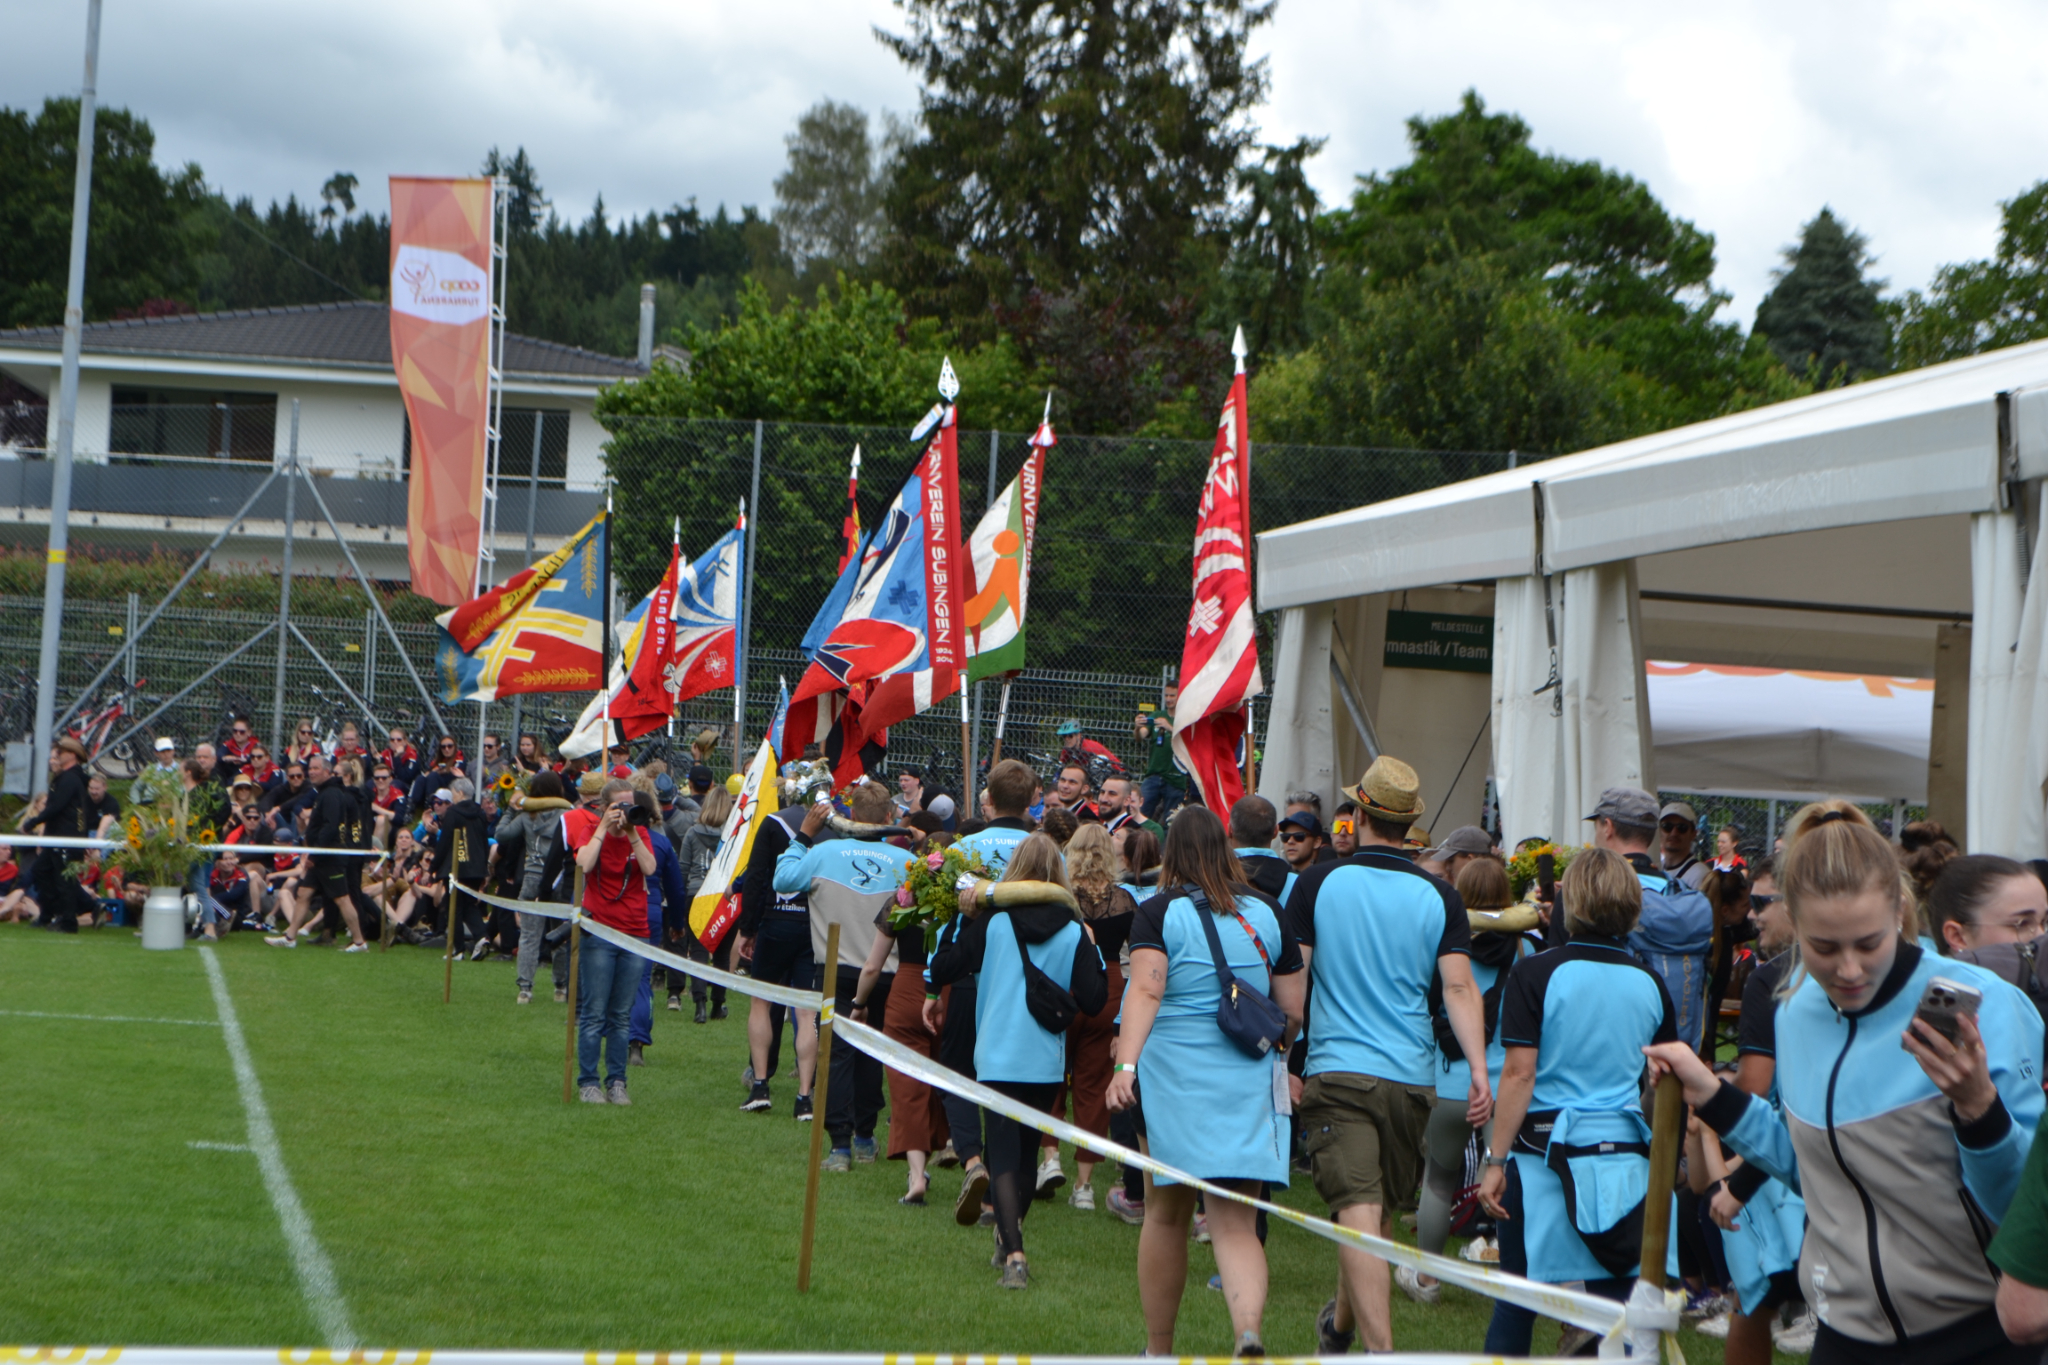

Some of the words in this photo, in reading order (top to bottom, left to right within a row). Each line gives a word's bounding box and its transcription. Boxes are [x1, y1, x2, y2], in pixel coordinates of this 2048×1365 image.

[932, 546, 950, 643] SUBINGEN
[1431, 622, 1485, 634] MELDESTELLE
[981, 838, 993, 846] TV
[853, 850, 894, 865] SUBINGEN
[708, 914, 726, 938] 2018
[1679, 954, 1692, 1026] ORTOVOX
